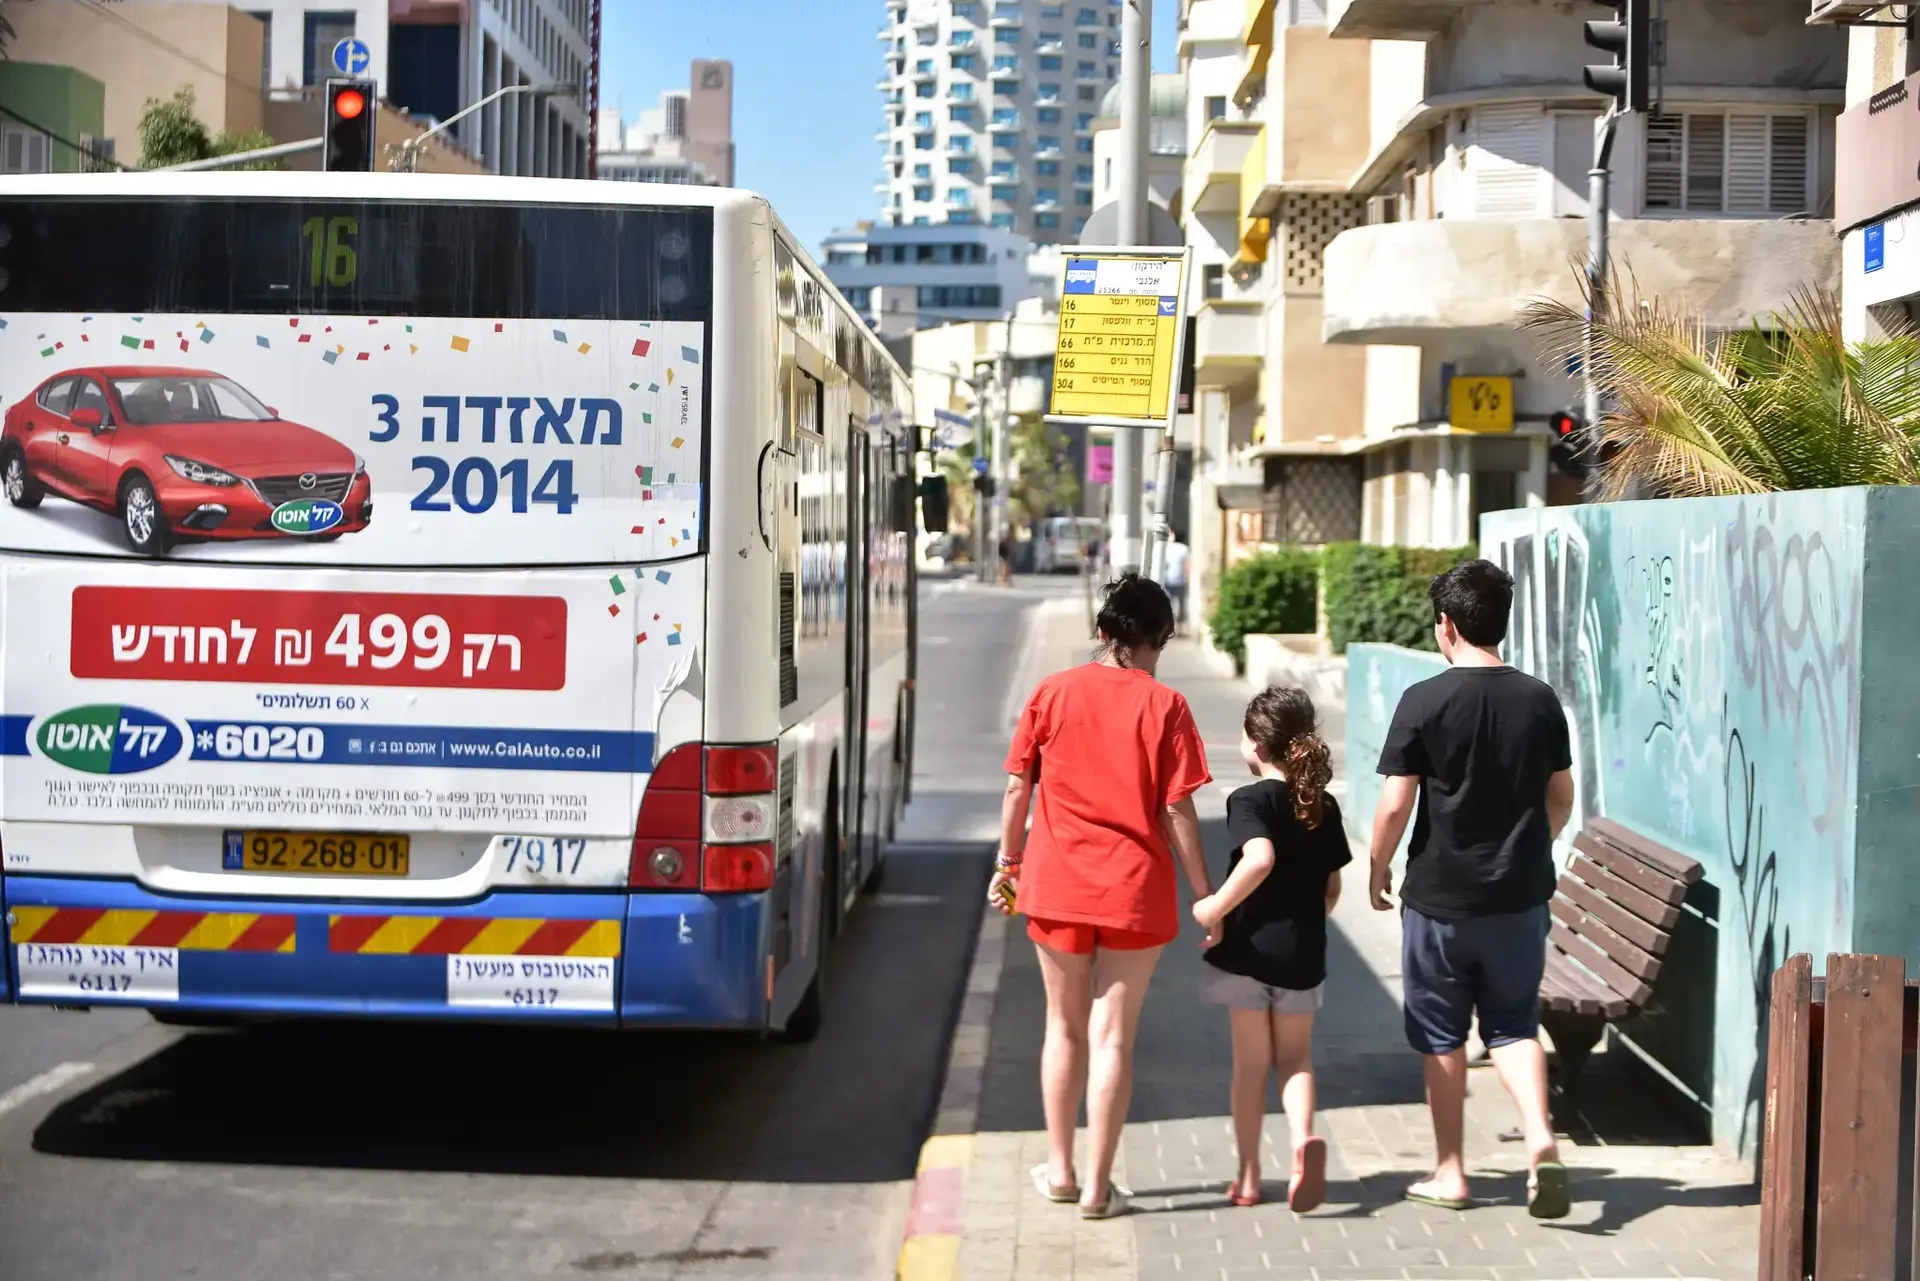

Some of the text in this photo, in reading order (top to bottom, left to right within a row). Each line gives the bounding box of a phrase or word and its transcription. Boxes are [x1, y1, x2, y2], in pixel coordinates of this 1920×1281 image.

[302, 216, 359, 287] 16
[1136, 277, 1160, 285] אלנבי
[1065, 300, 1076, 310] 16
[1135, 299, 1156, 307] מסוף
[1064, 318, 1075, 328] 17
[1061, 338, 1073, 348] 66
[1059, 357, 1075, 368] 166
[1134, 357, 1152, 365] הדר
[1057, 378, 1074, 389] 304
[1130, 378, 1151, 386] מסוף
[369, 393, 623, 445] מאזדה 3
[410, 455, 579, 514] 2014
[278, 505, 335, 524] קל אוטו
[111, 619, 258, 665] לחודש
[324, 613, 451, 670] 499
[462, 633, 522, 677] רק
[336, 696, 355, 710] 60
[46, 718, 167, 759] קל אוטו
[390, 741, 403, 754] גם
[405, 742, 436, 754] אתכם
[450, 742, 601, 759] www.CalAuto.co.il
[76, 780, 116, 793] לאישור
[162, 783, 203, 797] תקופה
[206, 784, 235, 798] בסוף
[240, 784, 281, 797] אופציה
[296, 786, 341, 801] מקדמה
[355, 788, 400, 800] חודשים
[473, 791, 496, 806] בסך
[500, 791, 544, 805] החודשי
[547, 793, 587, 806] המחיר
[117, 796, 169, 810] להמחשה
[174, 798, 224, 812] התמונות
[267, 800, 306, 813] כוללים
[310, 801, 362, 815] המחירים
[411, 803, 433, 817] גמר
[436, 804, 452, 817] עד
[502, 807, 538, 822] בכפוף
[502, 836, 586, 874] 7917
[92, 948, 126, 966] אני
[134, 948, 173, 972] איך
[455, 958, 609, 980] האוטובוס מעשן?
